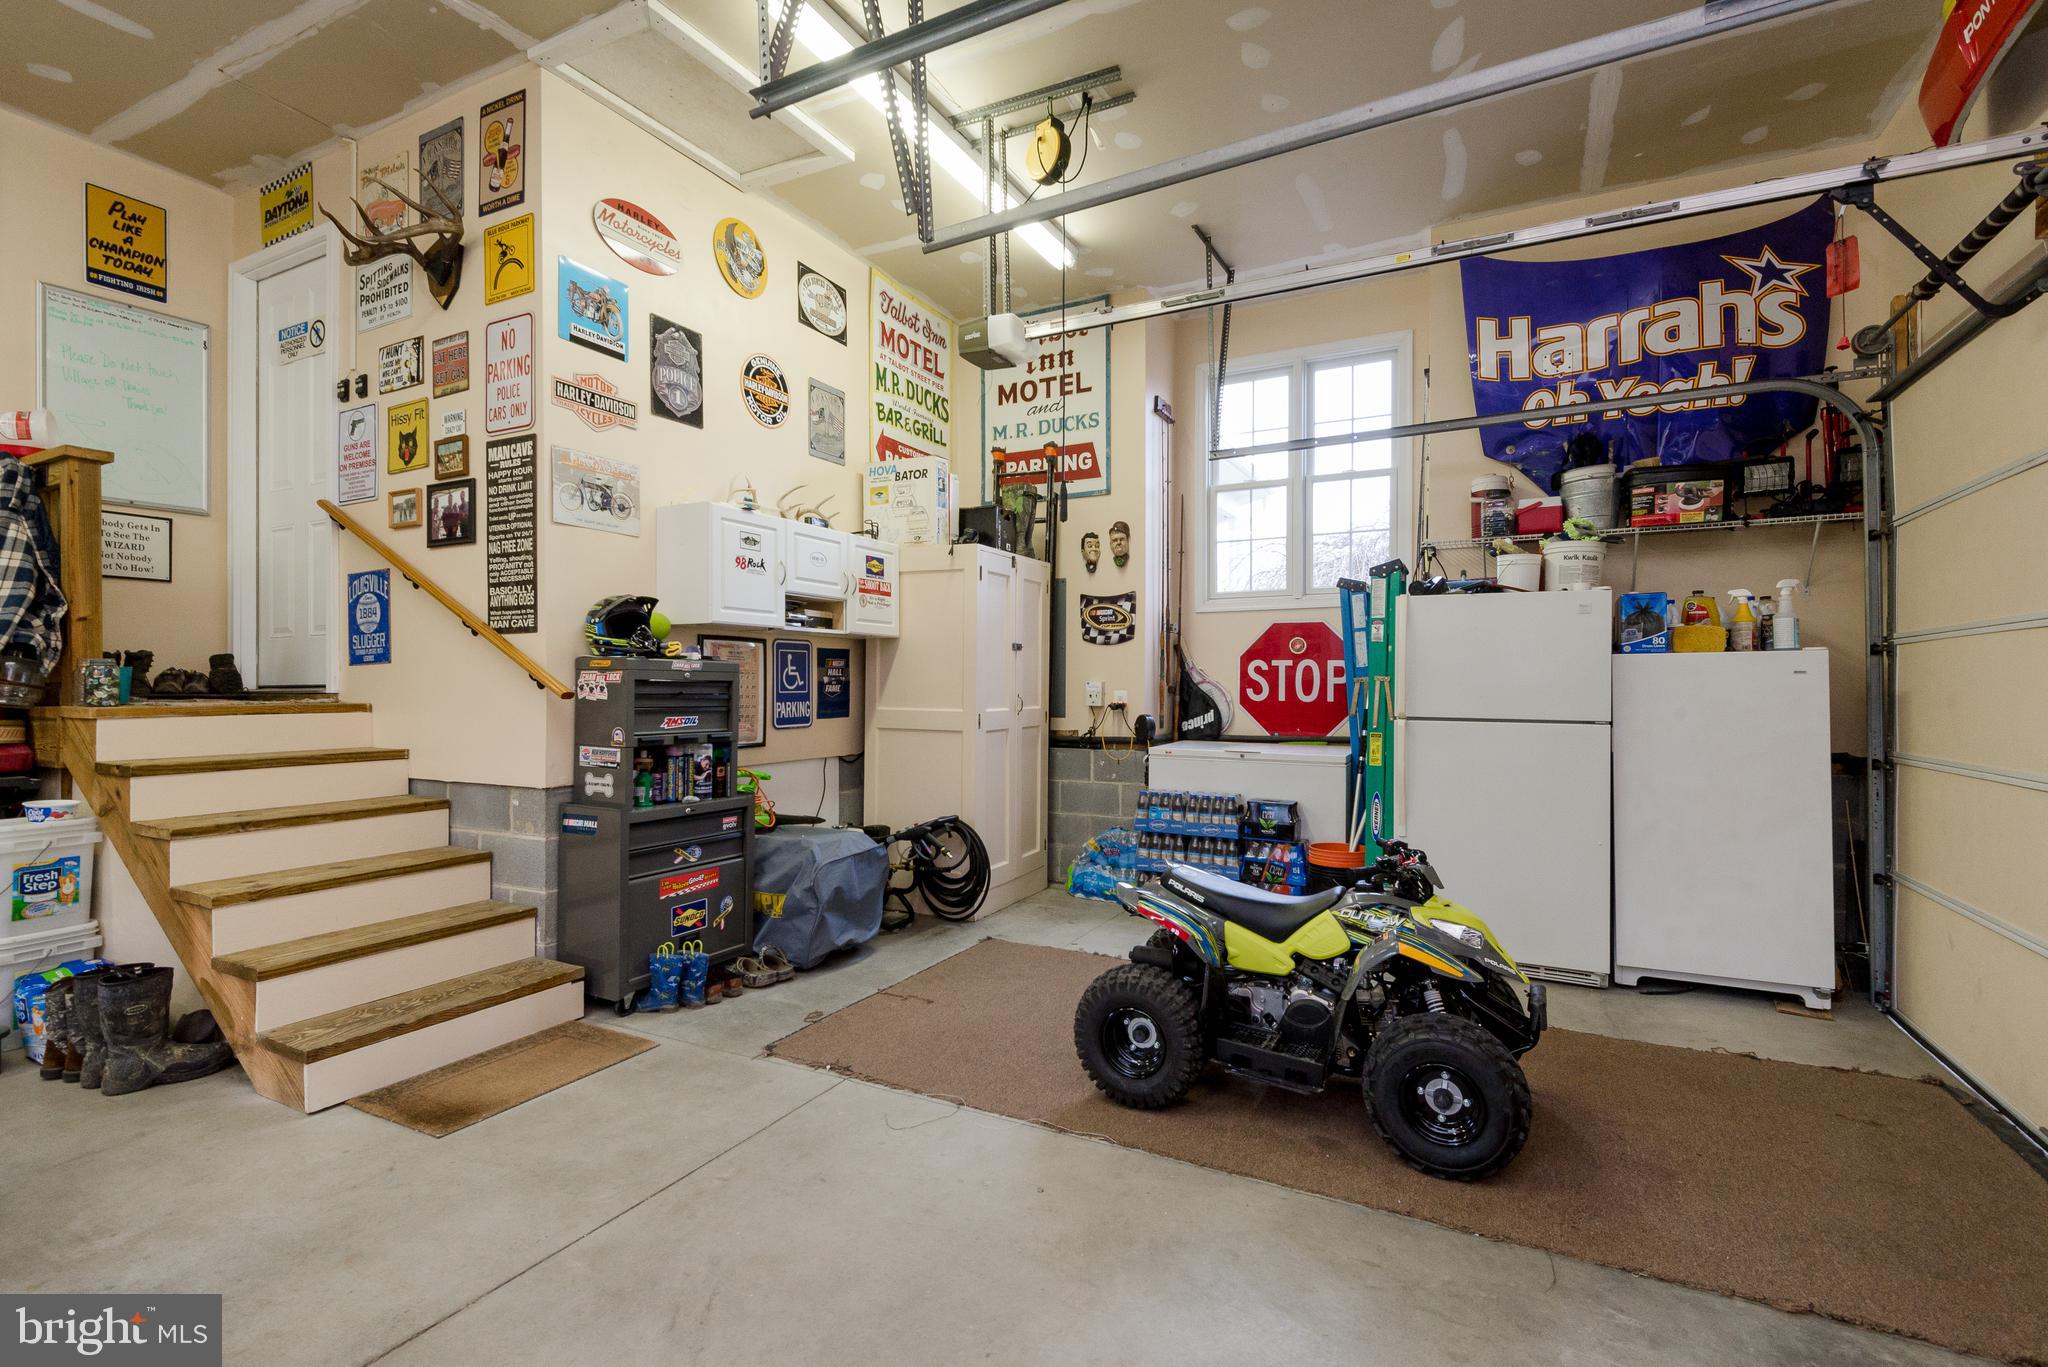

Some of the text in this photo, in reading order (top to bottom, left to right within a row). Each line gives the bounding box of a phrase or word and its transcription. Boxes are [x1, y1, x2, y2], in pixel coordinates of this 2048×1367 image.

[1963, 0, 1996, 44] PON
[264, 190, 309, 224] DAYTONA
[113, 220, 143, 237] LIKE
[599, 208, 682, 260] Motorcycles
[122, 236, 134, 246] A
[89, 237, 166, 268] CHAMPION
[102, 254, 153, 278] TODAY
[98, 273, 156, 296] FIGHTING IRISH
[360, 263, 393, 291] SPITTING
[377, 263, 409, 290] SIDEWALKS
[360, 282, 409, 307] PROHIBITED
[879, 290, 920, 334] Talbot
[922, 319, 947, 350] Inn
[281, 323, 306, 340] NOTICE
[501, 328, 515, 350] NO
[386, 343, 404, 359] HUNT
[433, 346, 467, 365] EAT HERE
[880, 320, 945, 381] MOTEL
[435, 367, 465, 385] GET GAS
[487, 355, 530, 383] PARKING
[751, 357, 782, 377] GENUINE
[880, 353, 944, 391] AT TALBOT STREET PIER
[580, 377, 613, 395] MOTOR
[660, 367, 695, 391] POLICE
[497, 383, 520, 400] POLICE
[875, 362, 950, 424] M.R. DUCKS
[998, 372, 1092, 406] MOTEL
[557, 383, 635, 419] HARLEY-DAVIDSON
[1027, 398, 1065, 417] and
[391, 408, 425, 428] Hissy Fit
[444, 412, 463, 424] WARNING
[489, 402, 528, 422] CARS ONLY
[580, 408, 614, 426] CYCLES
[747, 396, 787, 425] MOTOR OIL
[876, 402, 903, 429] BAR
[1039, 411, 1100, 436] DUCKS
[344, 440, 371, 452] GUNS ARE
[488, 441, 533, 462] MAN CAVE
[343, 450, 371, 461] WELCOME
[500, 458, 521, 469] RULES
[339, 459, 376, 472] ON PREMISES
[488, 466, 533, 480] HAPPY HOUR
[869, 465, 928, 482] HOVA BATOR
[489, 481, 533, 495] NO DRINK LIMIT
[113, 530, 131, 539] See
[132, 532, 151, 542] The
[127, 521, 149, 531] Gets
[151, 524, 161, 533] In
[104, 540, 145, 551] WIZARD
[489, 537, 533, 554] NAG FREE ZONE
[116, 552, 152, 564] Nobody
[489, 561, 523, 571] PROFANITY
[735, 556, 767, 572] 98 Rock
[115, 563, 128, 571] No
[130, 564, 154, 574] How!
[349, 574, 389, 604] LOUISVILLE
[490, 593, 534, 607] ANYTHING GOES
[360, 607, 378, 619] 1884
[1099, 615, 1116, 623] Sprint
[490, 618, 534, 629] MAN CAVE
[352, 633, 385, 649] SLUGGER
[1652, 636, 1665, 645] 80
[827, 668, 843, 676] HALL
[1246, 659, 1346, 703] STOP
[825, 684, 842, 692] FAME
[776, 701, 811, 719] PARKING
[664, 716, 698, 728] AMSOIL
[23, 870, 58, 884] Fresh
[24, 881, 57, 893] Step
[1168, 879, 1205, 904] POLARIS
[674, 910, 706, 926] SUNOCO
[1340, 908, 1407, 928] OUTLAW
[1484, 957, 1517, 975] POLARIS
